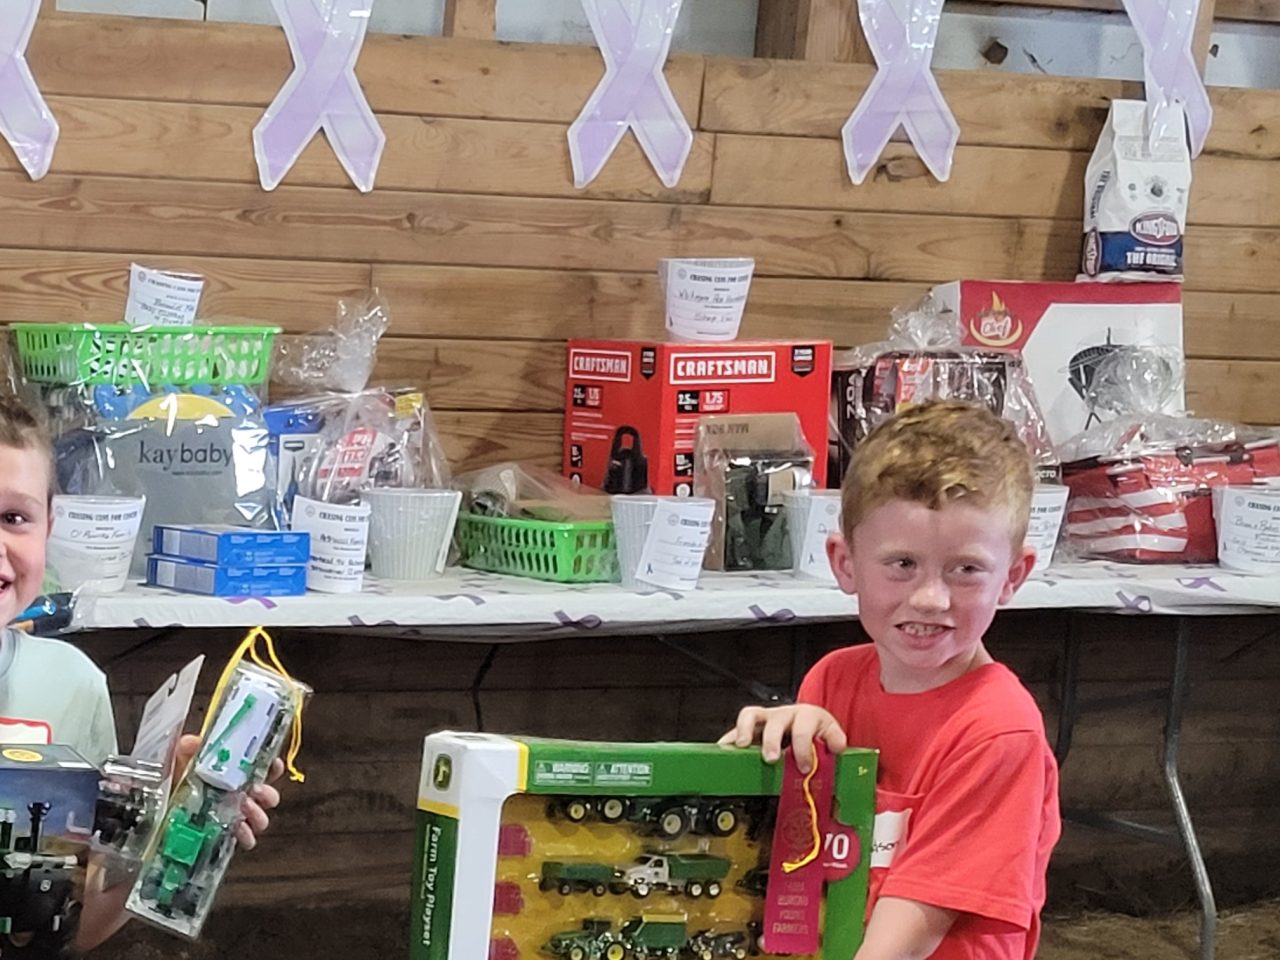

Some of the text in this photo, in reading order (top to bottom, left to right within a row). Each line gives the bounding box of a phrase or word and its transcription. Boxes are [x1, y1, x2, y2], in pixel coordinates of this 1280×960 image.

[574, 356, 627, 374] CRAFTSMAN
[677, 359, 768, 377] CRAFTSMAN
[429, 826, 442, 863] Farm
[425, 866, 438, 891] Toy
[422, 894, 436, 947] Playset
[773, 921, 809, 935] FARMERS
